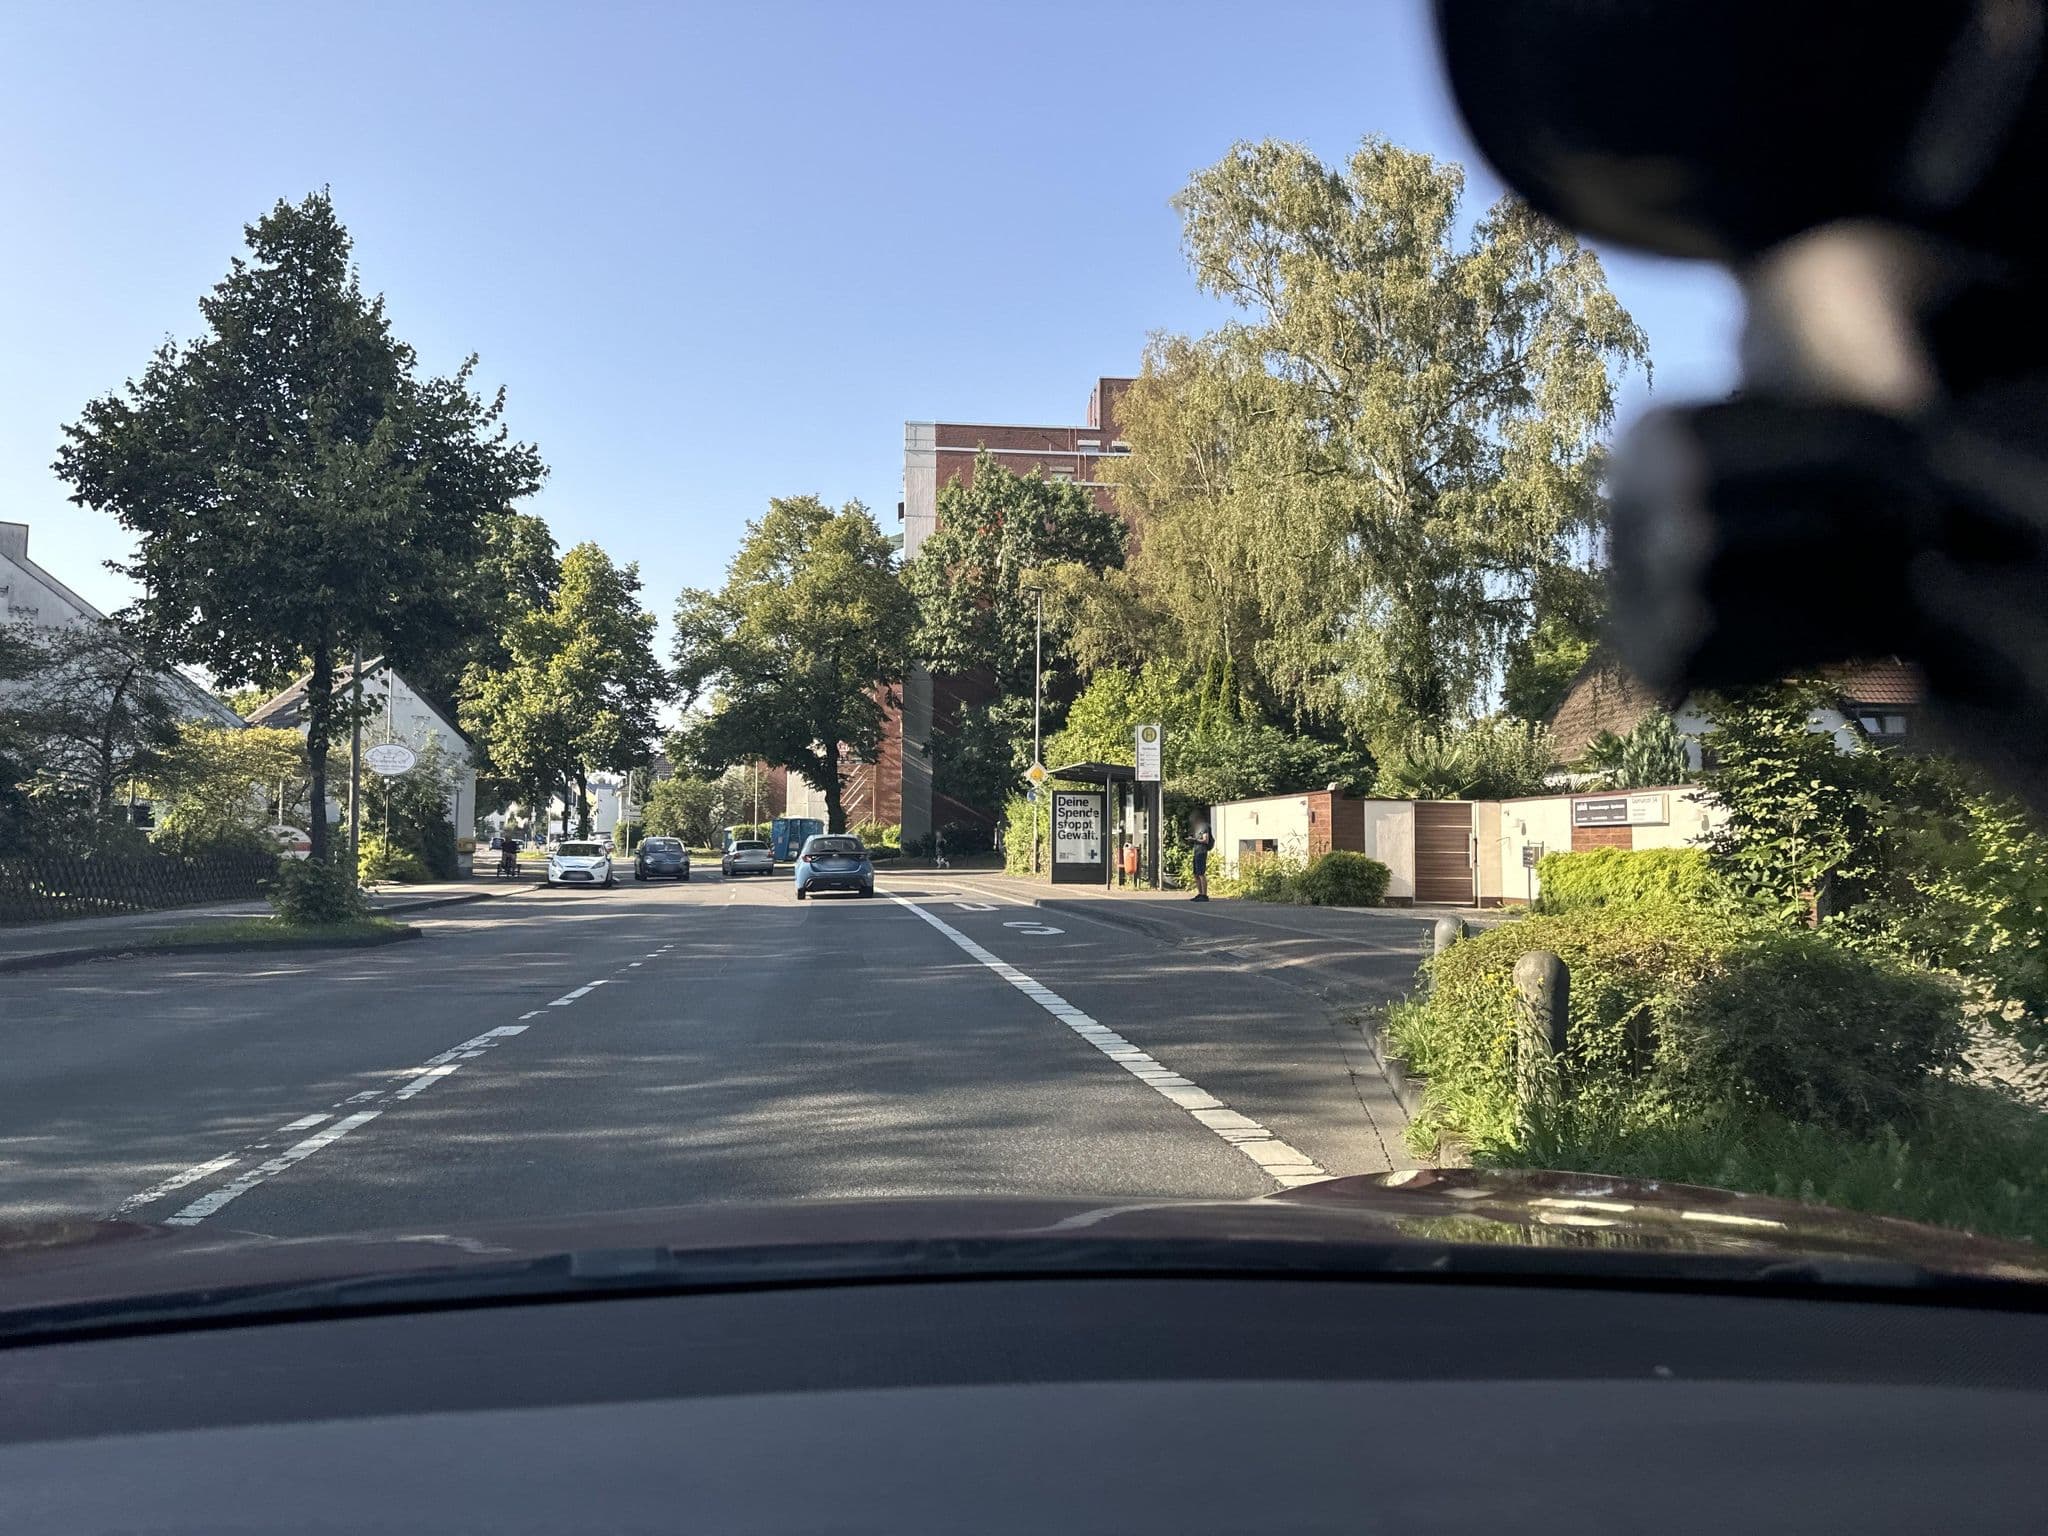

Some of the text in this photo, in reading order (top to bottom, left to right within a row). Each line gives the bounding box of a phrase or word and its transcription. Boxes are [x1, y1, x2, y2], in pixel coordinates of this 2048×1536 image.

[1058, 796, 1089, 807] Deine
[1058, 807, 1100, 819] Spende
[1057, 820, 1093, 831] stoppt
[1057, 830, 1099, 841] Gewalt.
